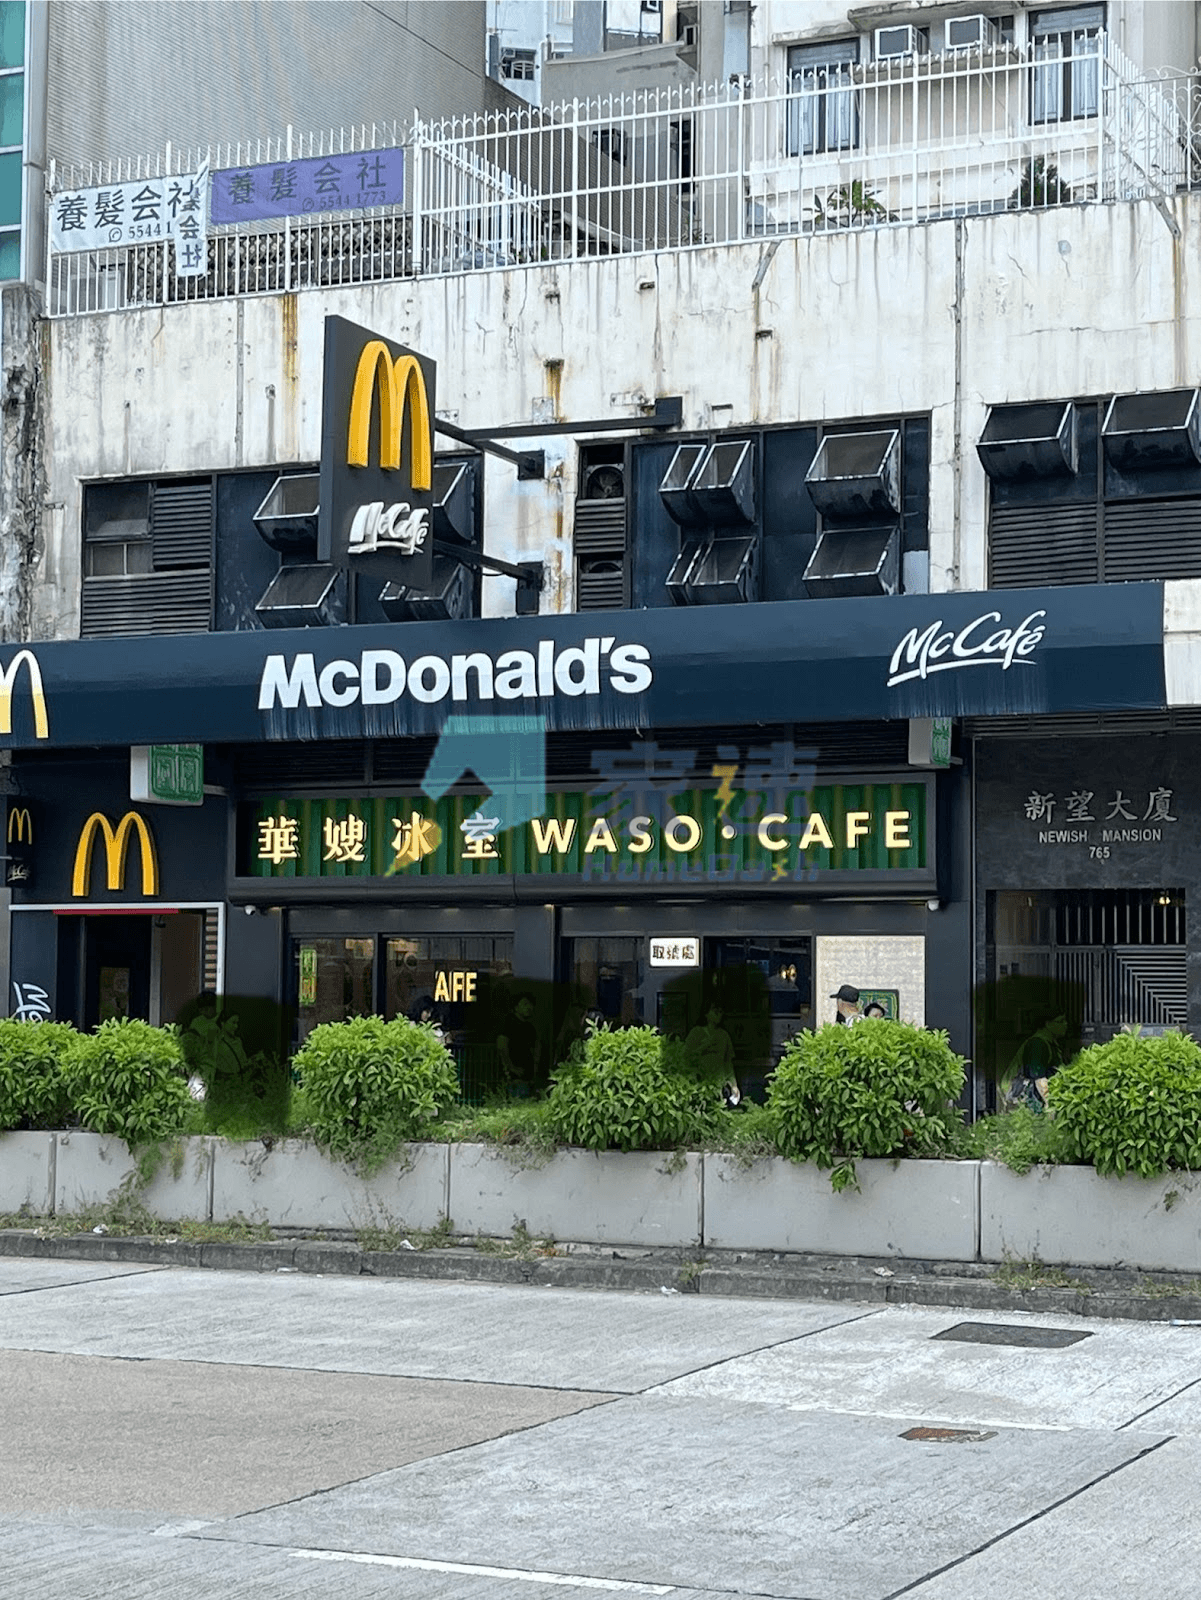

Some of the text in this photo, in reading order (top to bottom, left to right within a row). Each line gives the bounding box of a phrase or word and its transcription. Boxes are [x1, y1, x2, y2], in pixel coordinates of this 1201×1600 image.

[356, 191, 387, 205] 1773
[128, 223, 161, 239] 5544
[887, 610, 1046, 687] McCafé
[258, 637, 653, 709] McDonald's
[1024, 787, 1178, 823] 新望大廈
[258, 811, 501, 865] 華嫂冰室
[1039, 829, 1162, 843] NEWISH MANSION
[1089, 847, 1111, 859] 765
